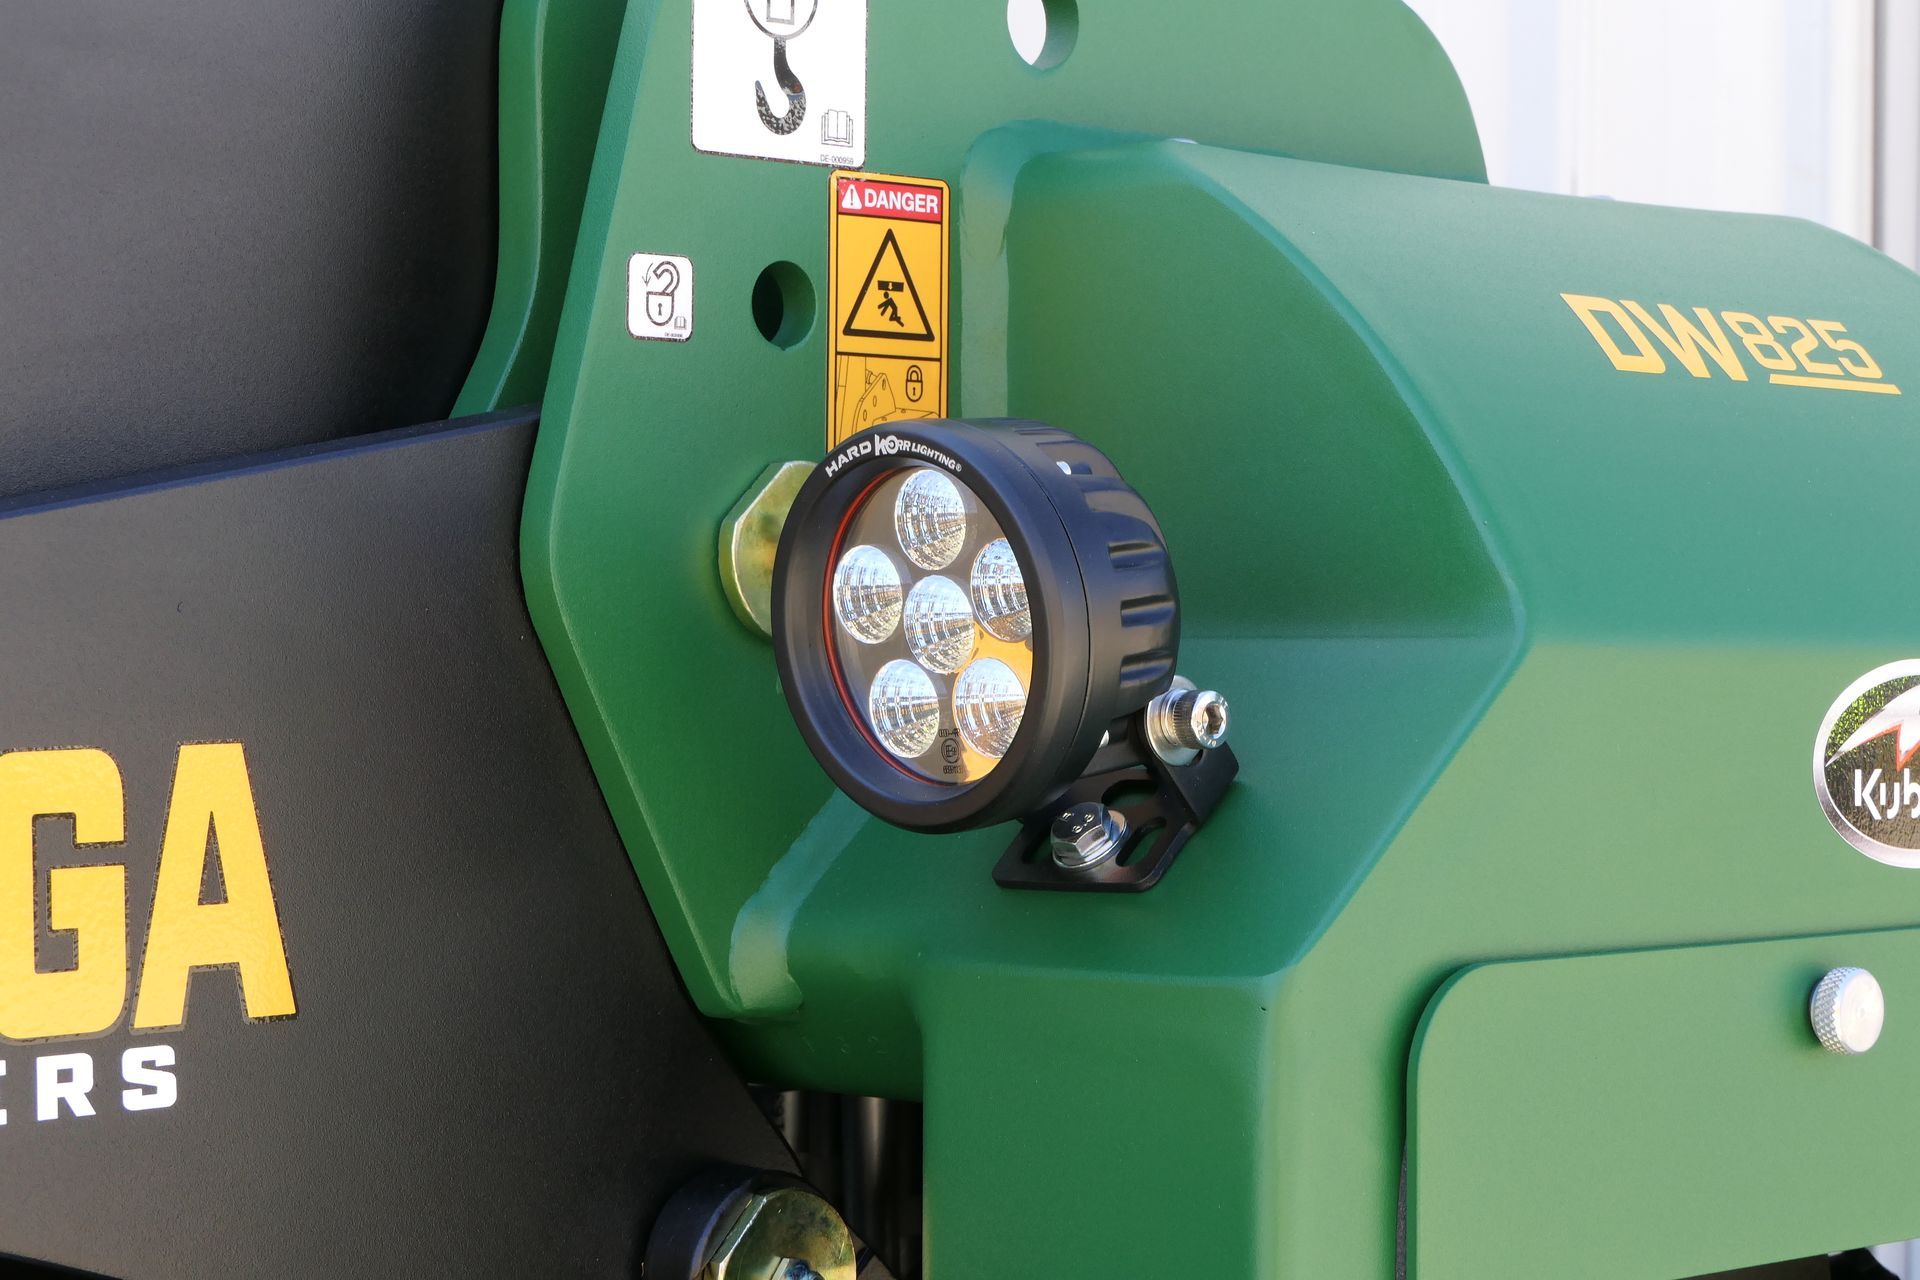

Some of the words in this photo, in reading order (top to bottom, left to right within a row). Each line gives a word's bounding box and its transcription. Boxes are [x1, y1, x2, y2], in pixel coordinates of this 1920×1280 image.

[864, 188, 939, 214] DANGER
[1559, 292, 1883, 382] DW825
[825, 440, 872, 478] HARD
[0, 741, 297, 1042] GA
